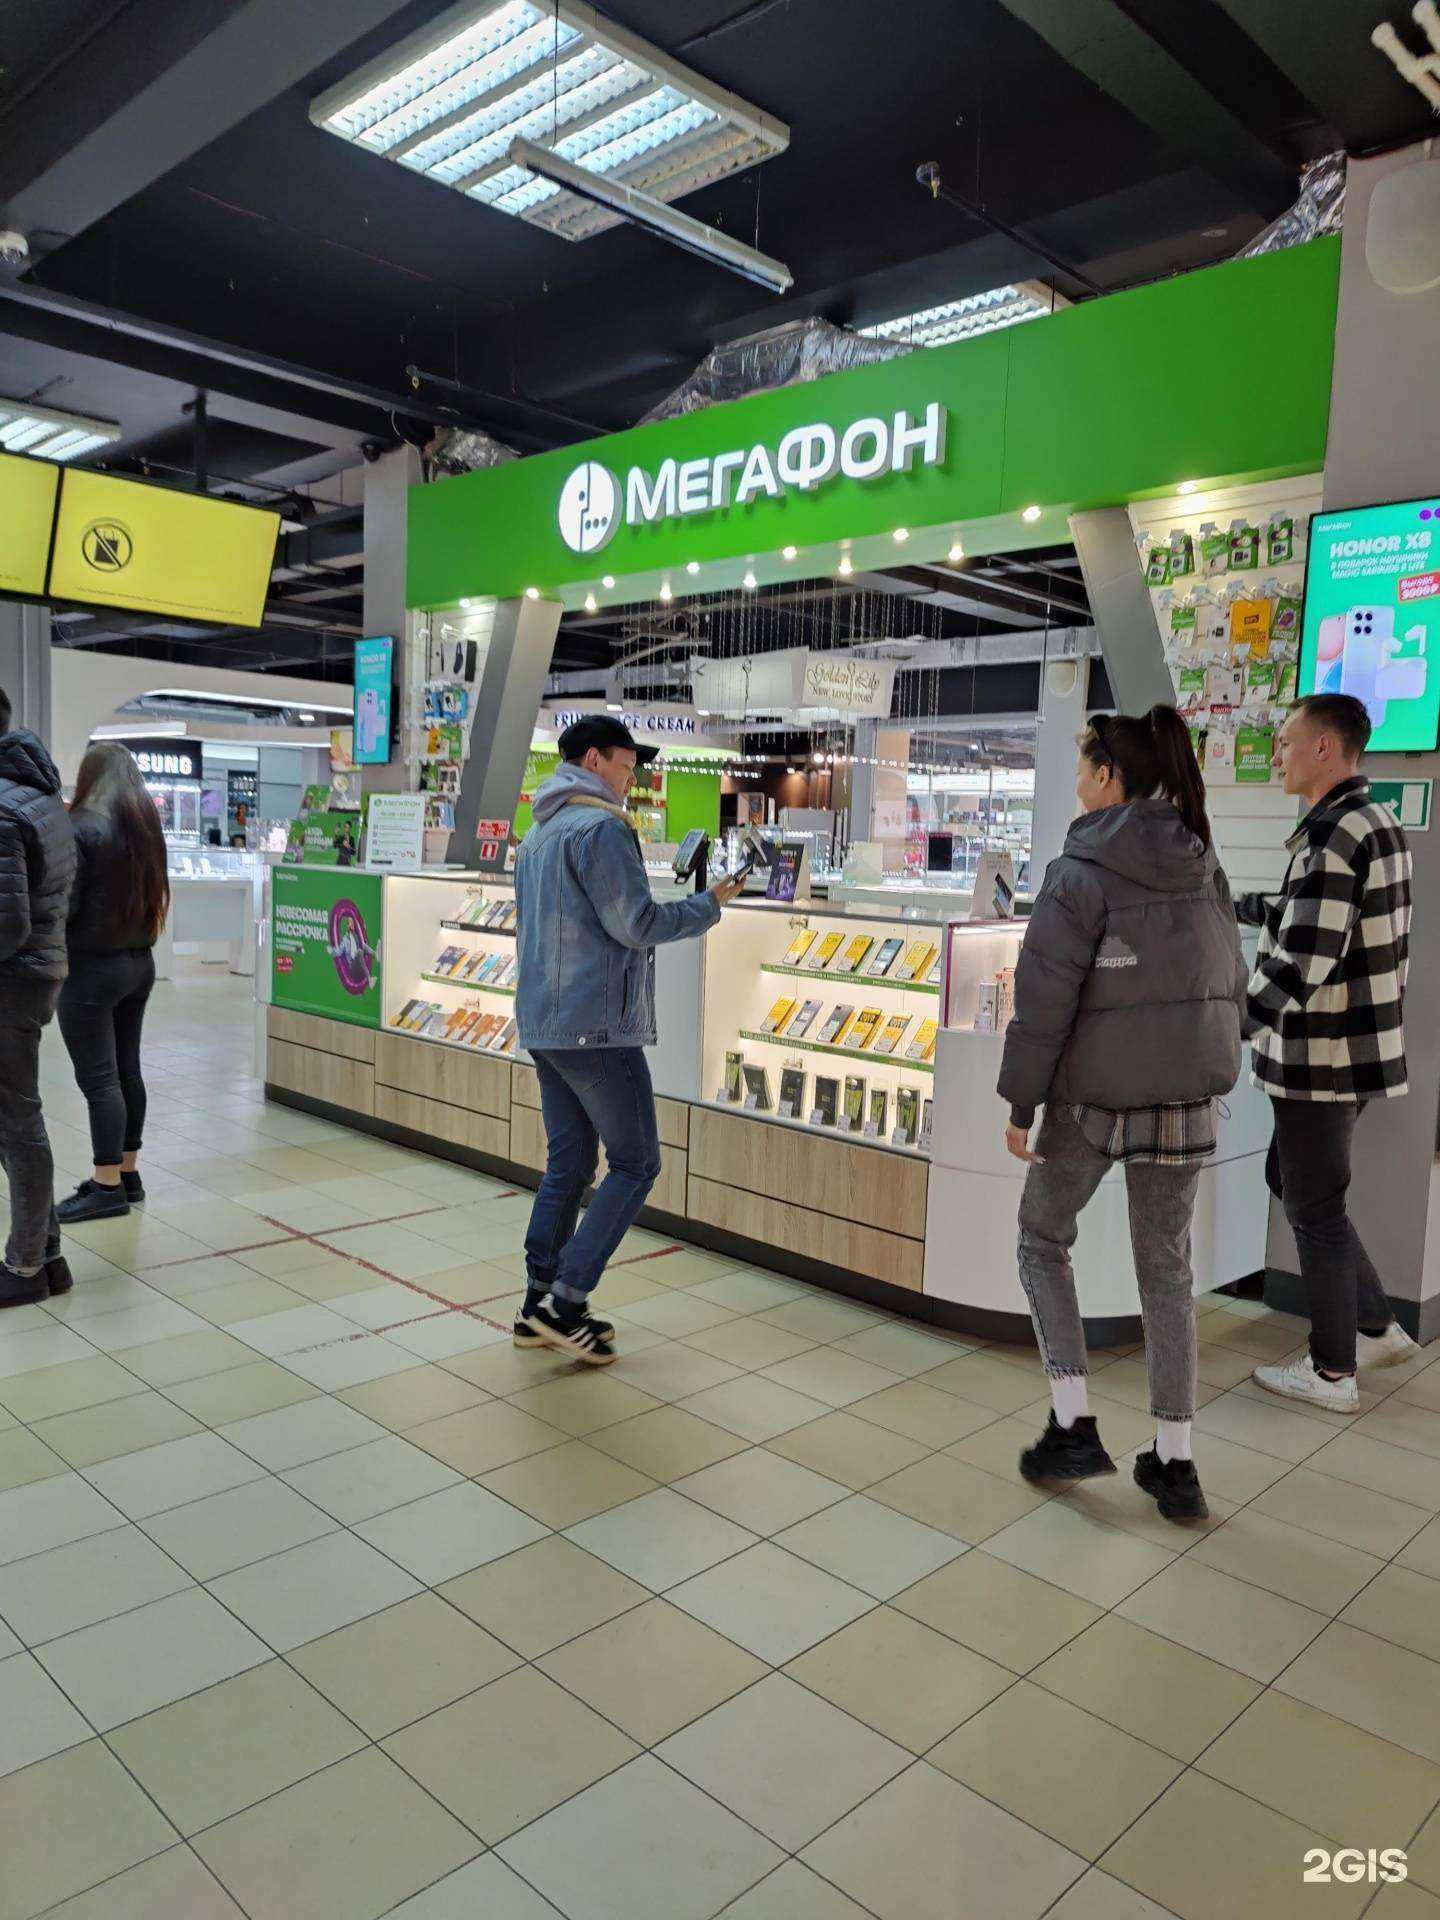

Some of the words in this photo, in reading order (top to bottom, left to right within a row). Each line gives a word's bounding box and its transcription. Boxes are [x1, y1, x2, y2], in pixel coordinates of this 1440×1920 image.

[625, 402, 944, 526] МЕГАФОН
[1330, 535, 1401, 558] HONOR
[1405, 531, 1432, 550] X8
[647, 715, 696, 734] CREAM
[130, 751, 192, 775] SUNG
[275, 904, 329, 924] НЕВЕСОМАЯ
[275, 921, 329, 942] РАССРОЧКА
